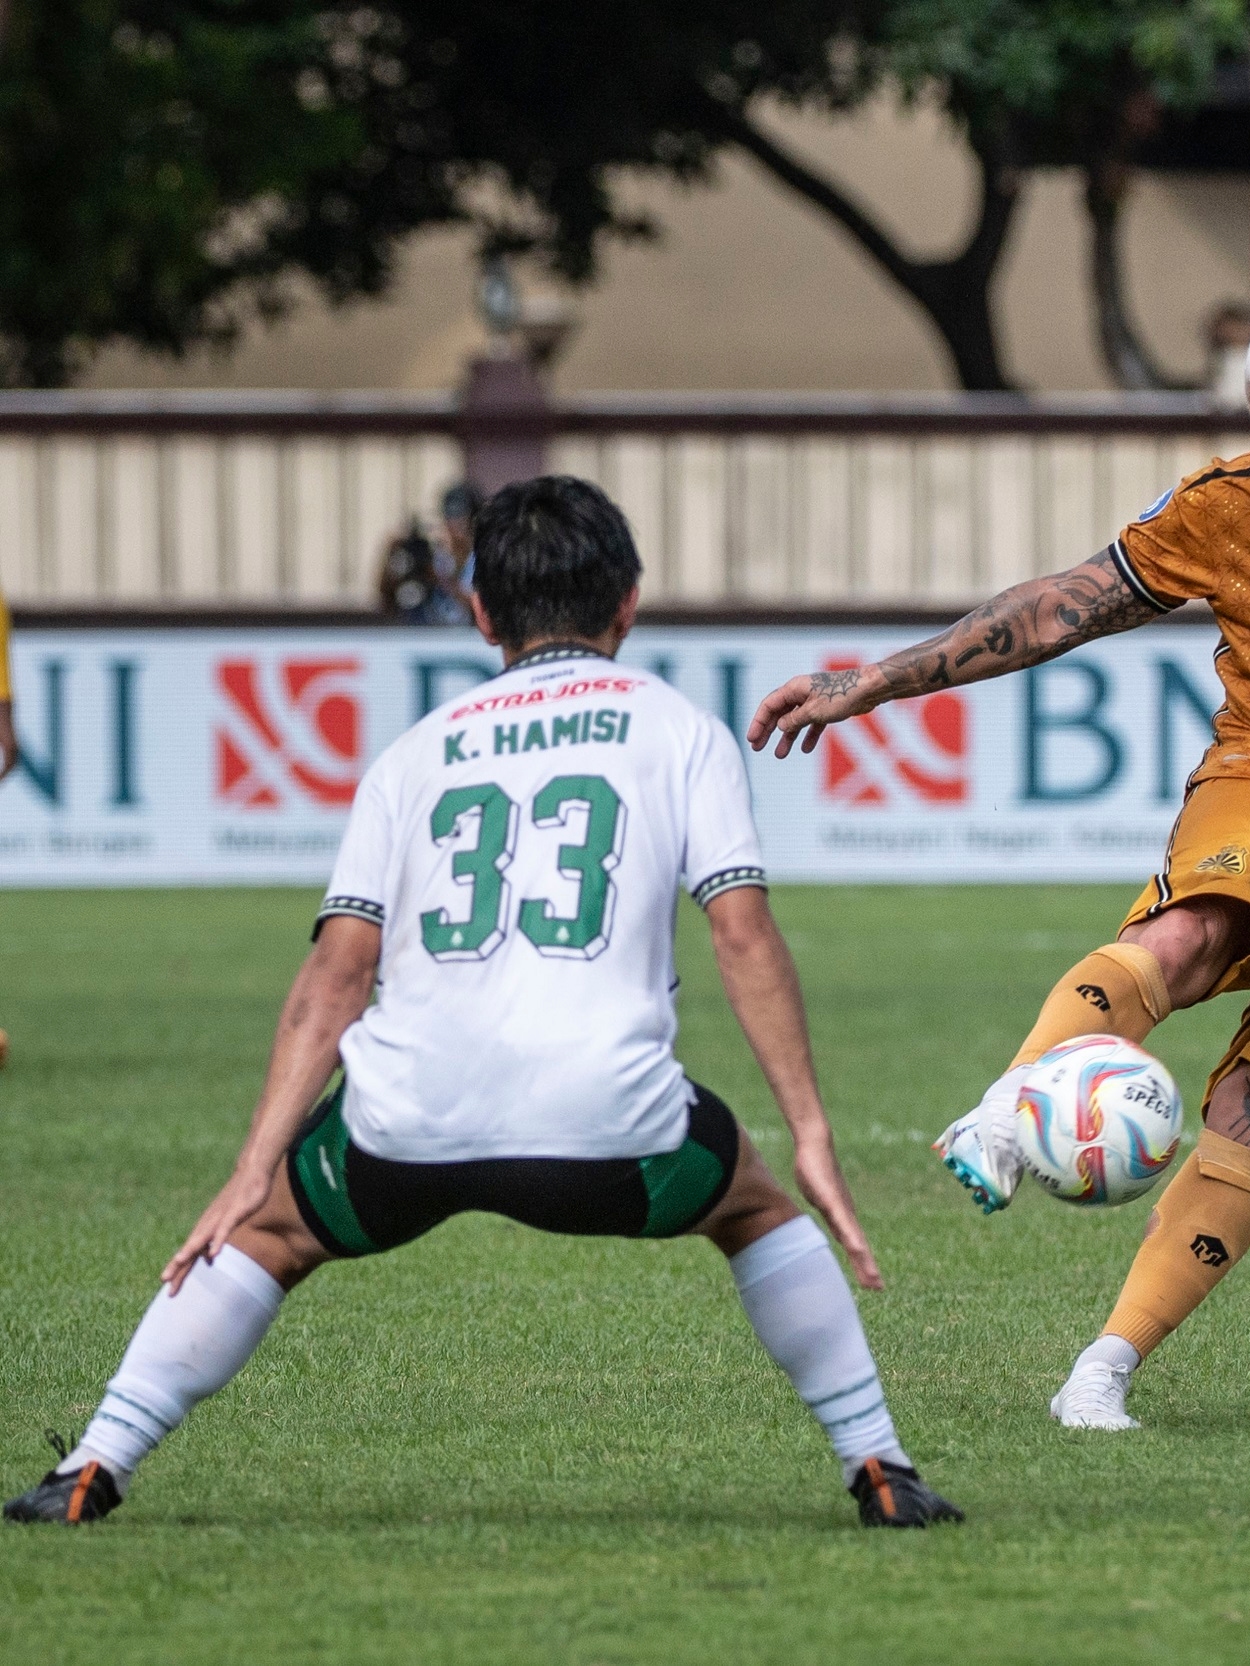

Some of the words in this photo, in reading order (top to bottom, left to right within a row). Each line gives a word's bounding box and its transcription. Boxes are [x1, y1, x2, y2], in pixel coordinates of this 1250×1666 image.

[552, 678, 636, 699] JOSS
[444, 730, 481, 766] K.
[493, 708, 631, 756] HAMISI
[419, 773, 629, 962] 33
[1123, 1085, 1173, 1119] SPECS
